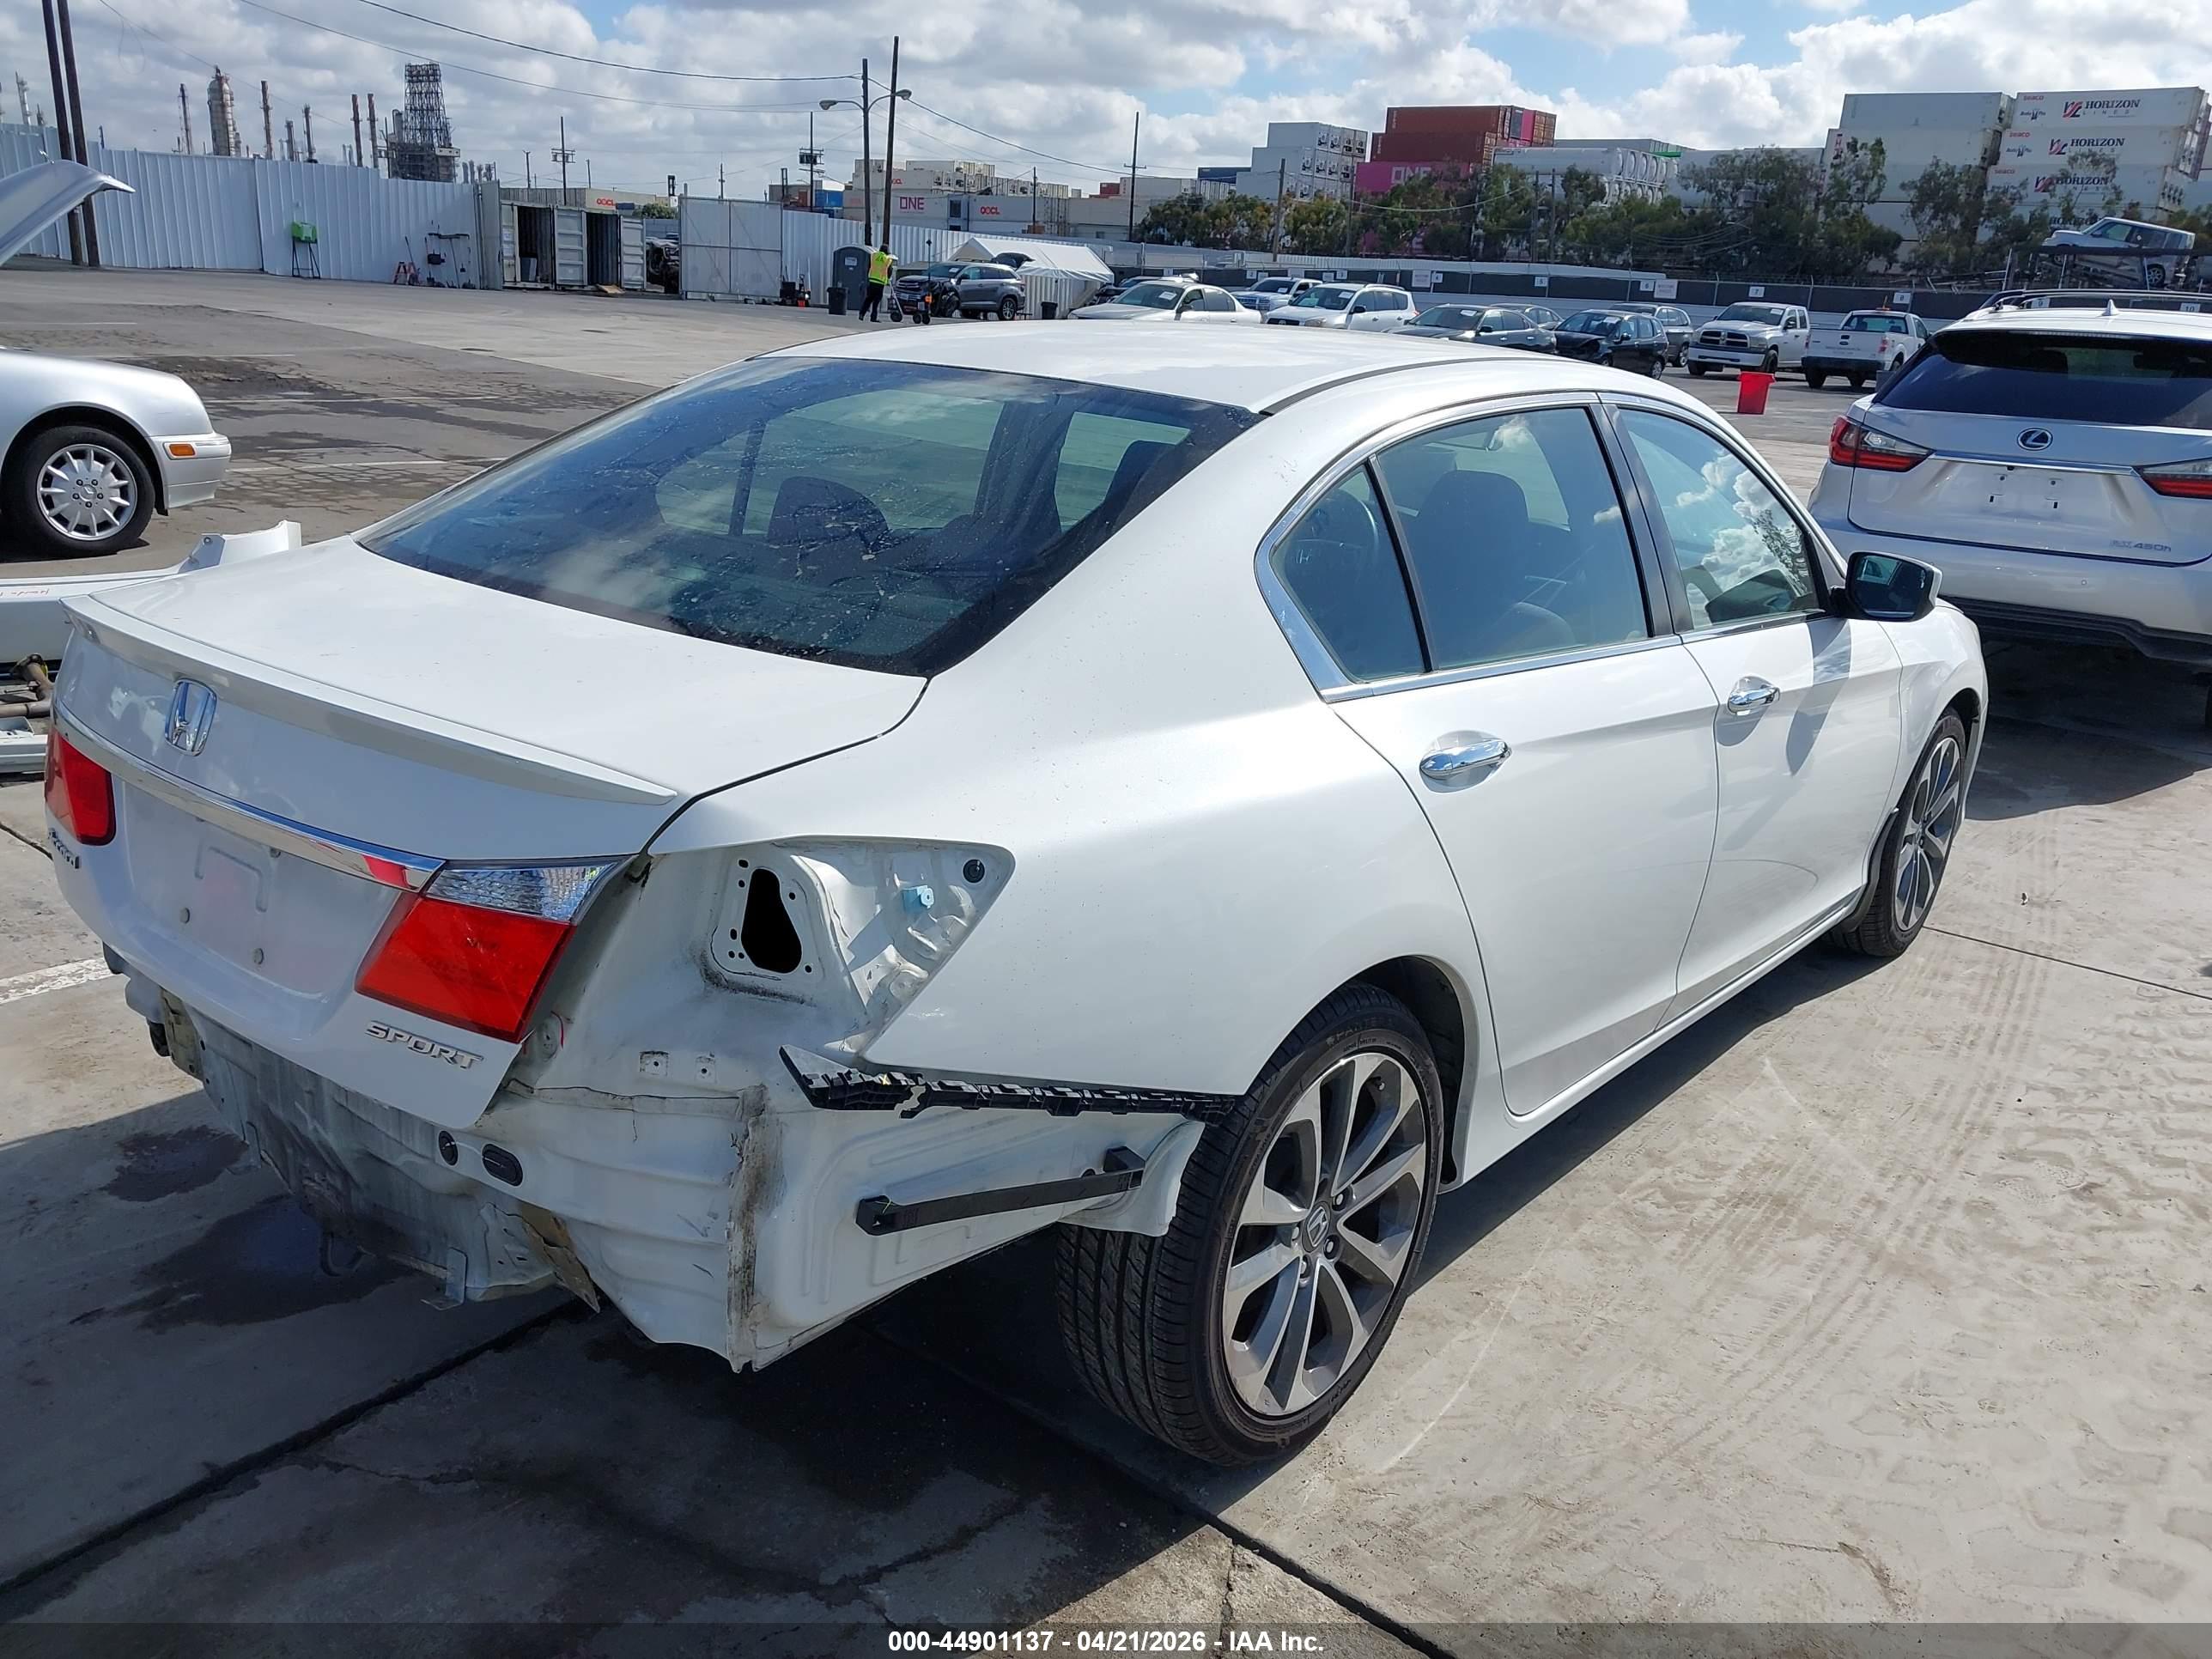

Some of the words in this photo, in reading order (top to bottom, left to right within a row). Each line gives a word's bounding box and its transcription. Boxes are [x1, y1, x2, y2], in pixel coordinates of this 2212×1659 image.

[2085, 99, 2141, 109] HORIZON
[2070, 137, 2125, 147] HORIZON
[899, 197, 925, 210] ONE
[980, 206, 1000, 215] OOCL
[364, 1019, 485, 1070] SPORT
